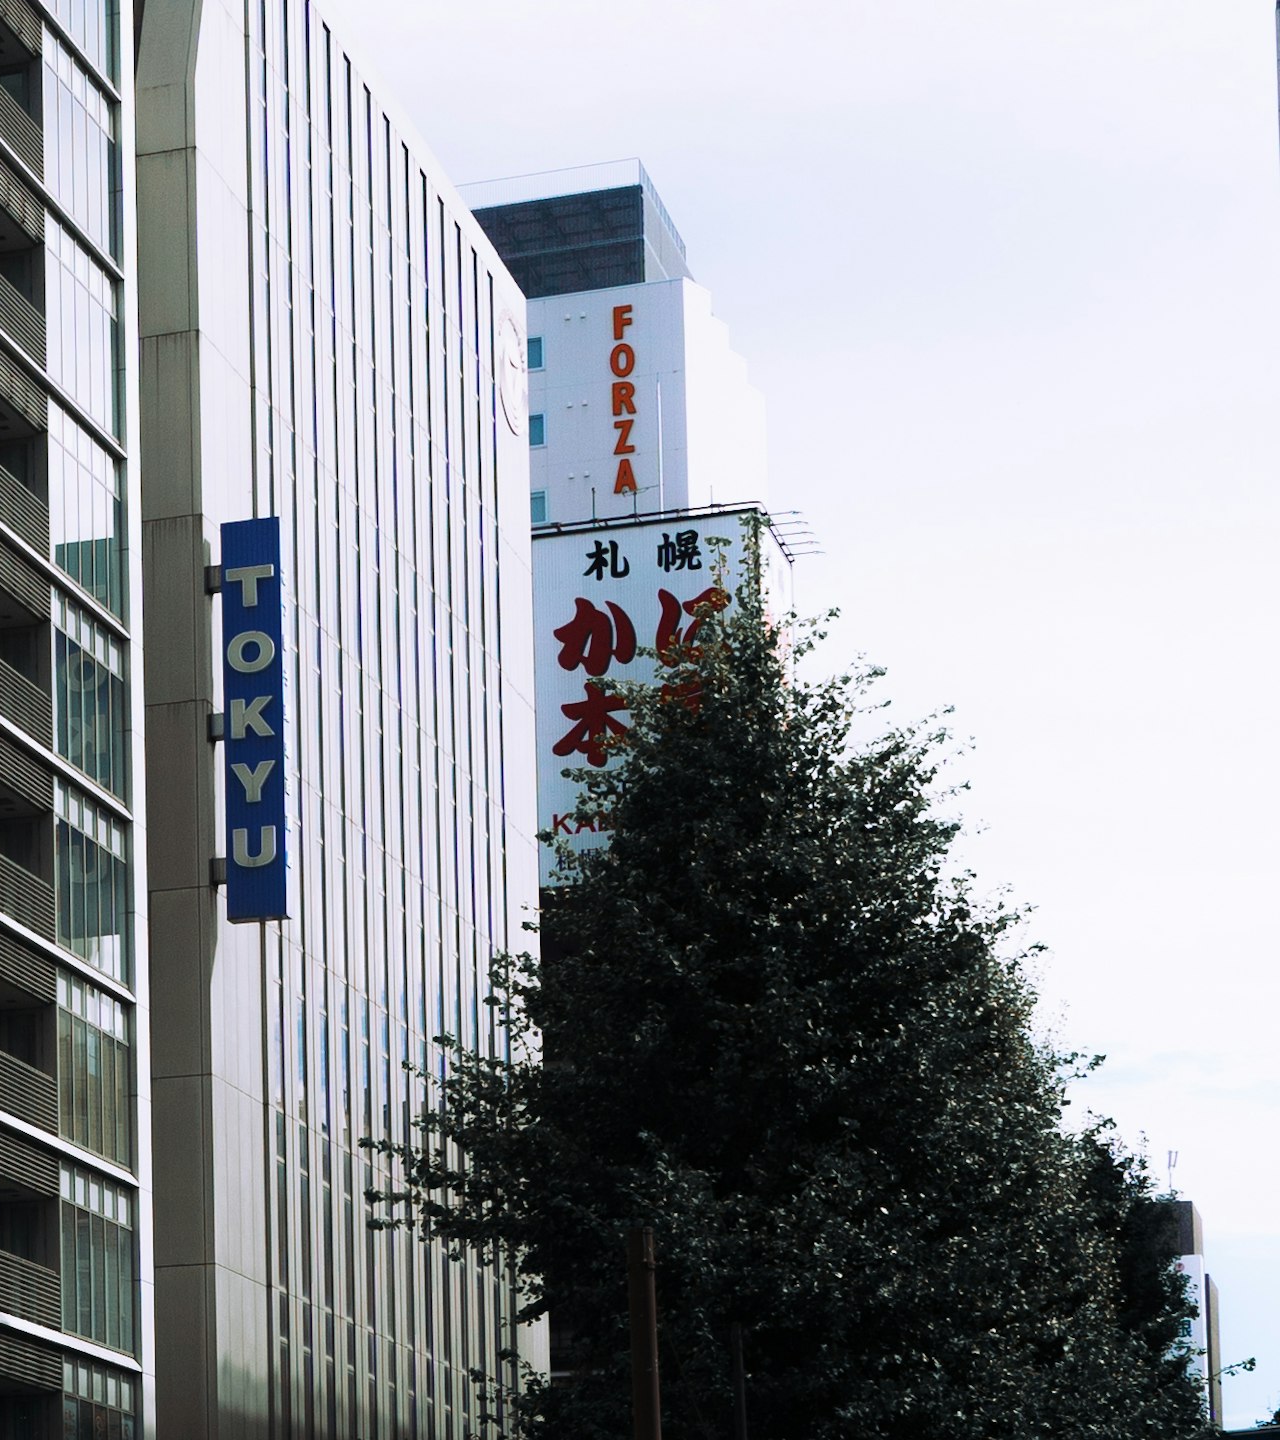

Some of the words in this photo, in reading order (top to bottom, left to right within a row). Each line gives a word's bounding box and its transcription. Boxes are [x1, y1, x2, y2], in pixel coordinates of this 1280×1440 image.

[610, 304, 637, 495] FORZA
[583, 529, 702, 581] 札幌
[225, 563, 277, 869] TOKYU
